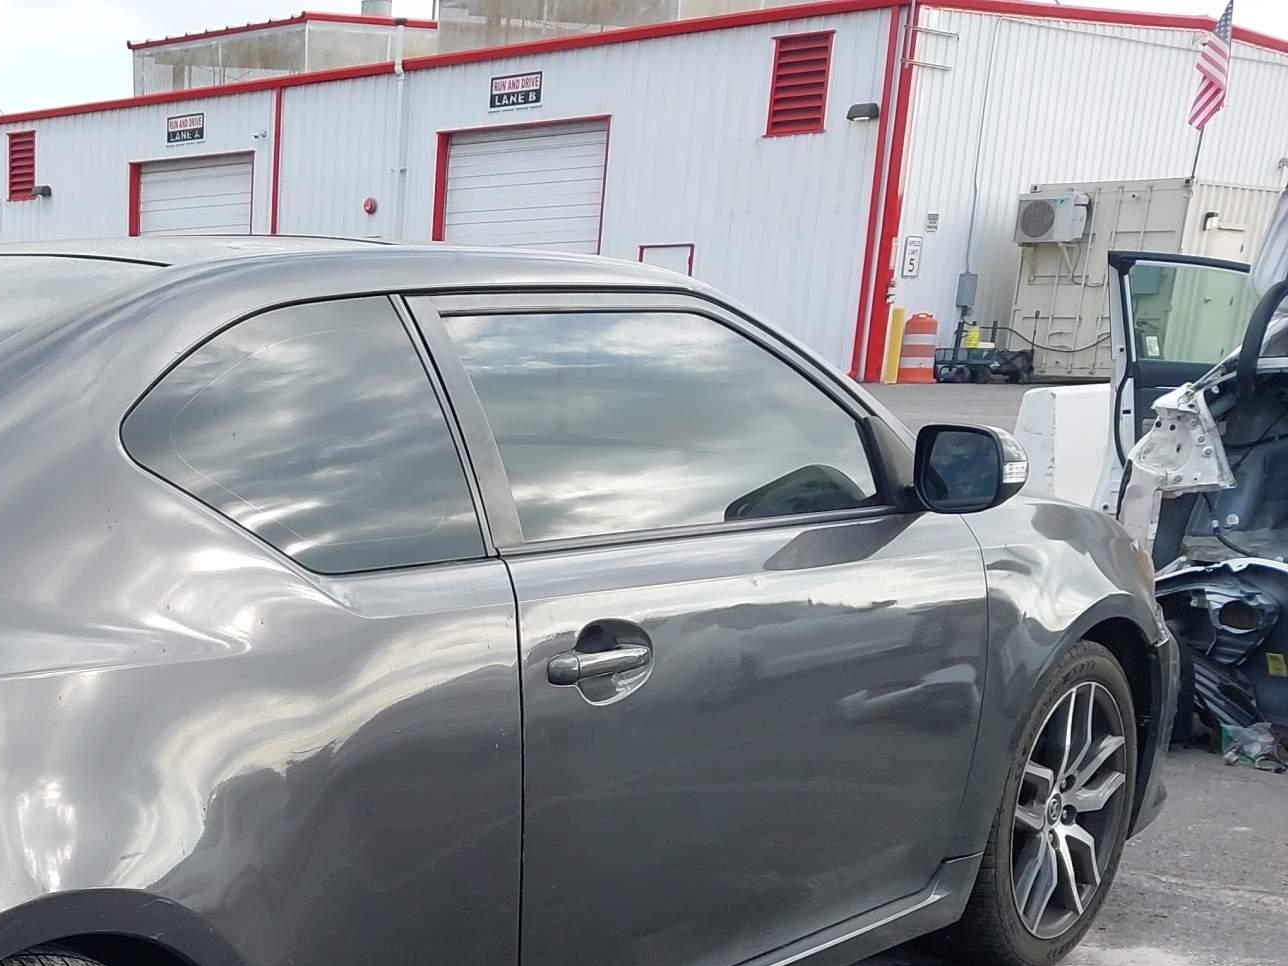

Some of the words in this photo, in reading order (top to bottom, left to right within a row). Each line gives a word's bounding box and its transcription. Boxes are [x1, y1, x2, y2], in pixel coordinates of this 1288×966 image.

[494, 80, 507, 92] RUN
[508, 79, 520, 90] AND
[522, 76, 539, 88] DRIVE
[495, 92, 525, 105] LANE
[528, 91, 536, 102] B
[170, 130, 192, 141] LANE
[908, 258, 915, 272] 5
